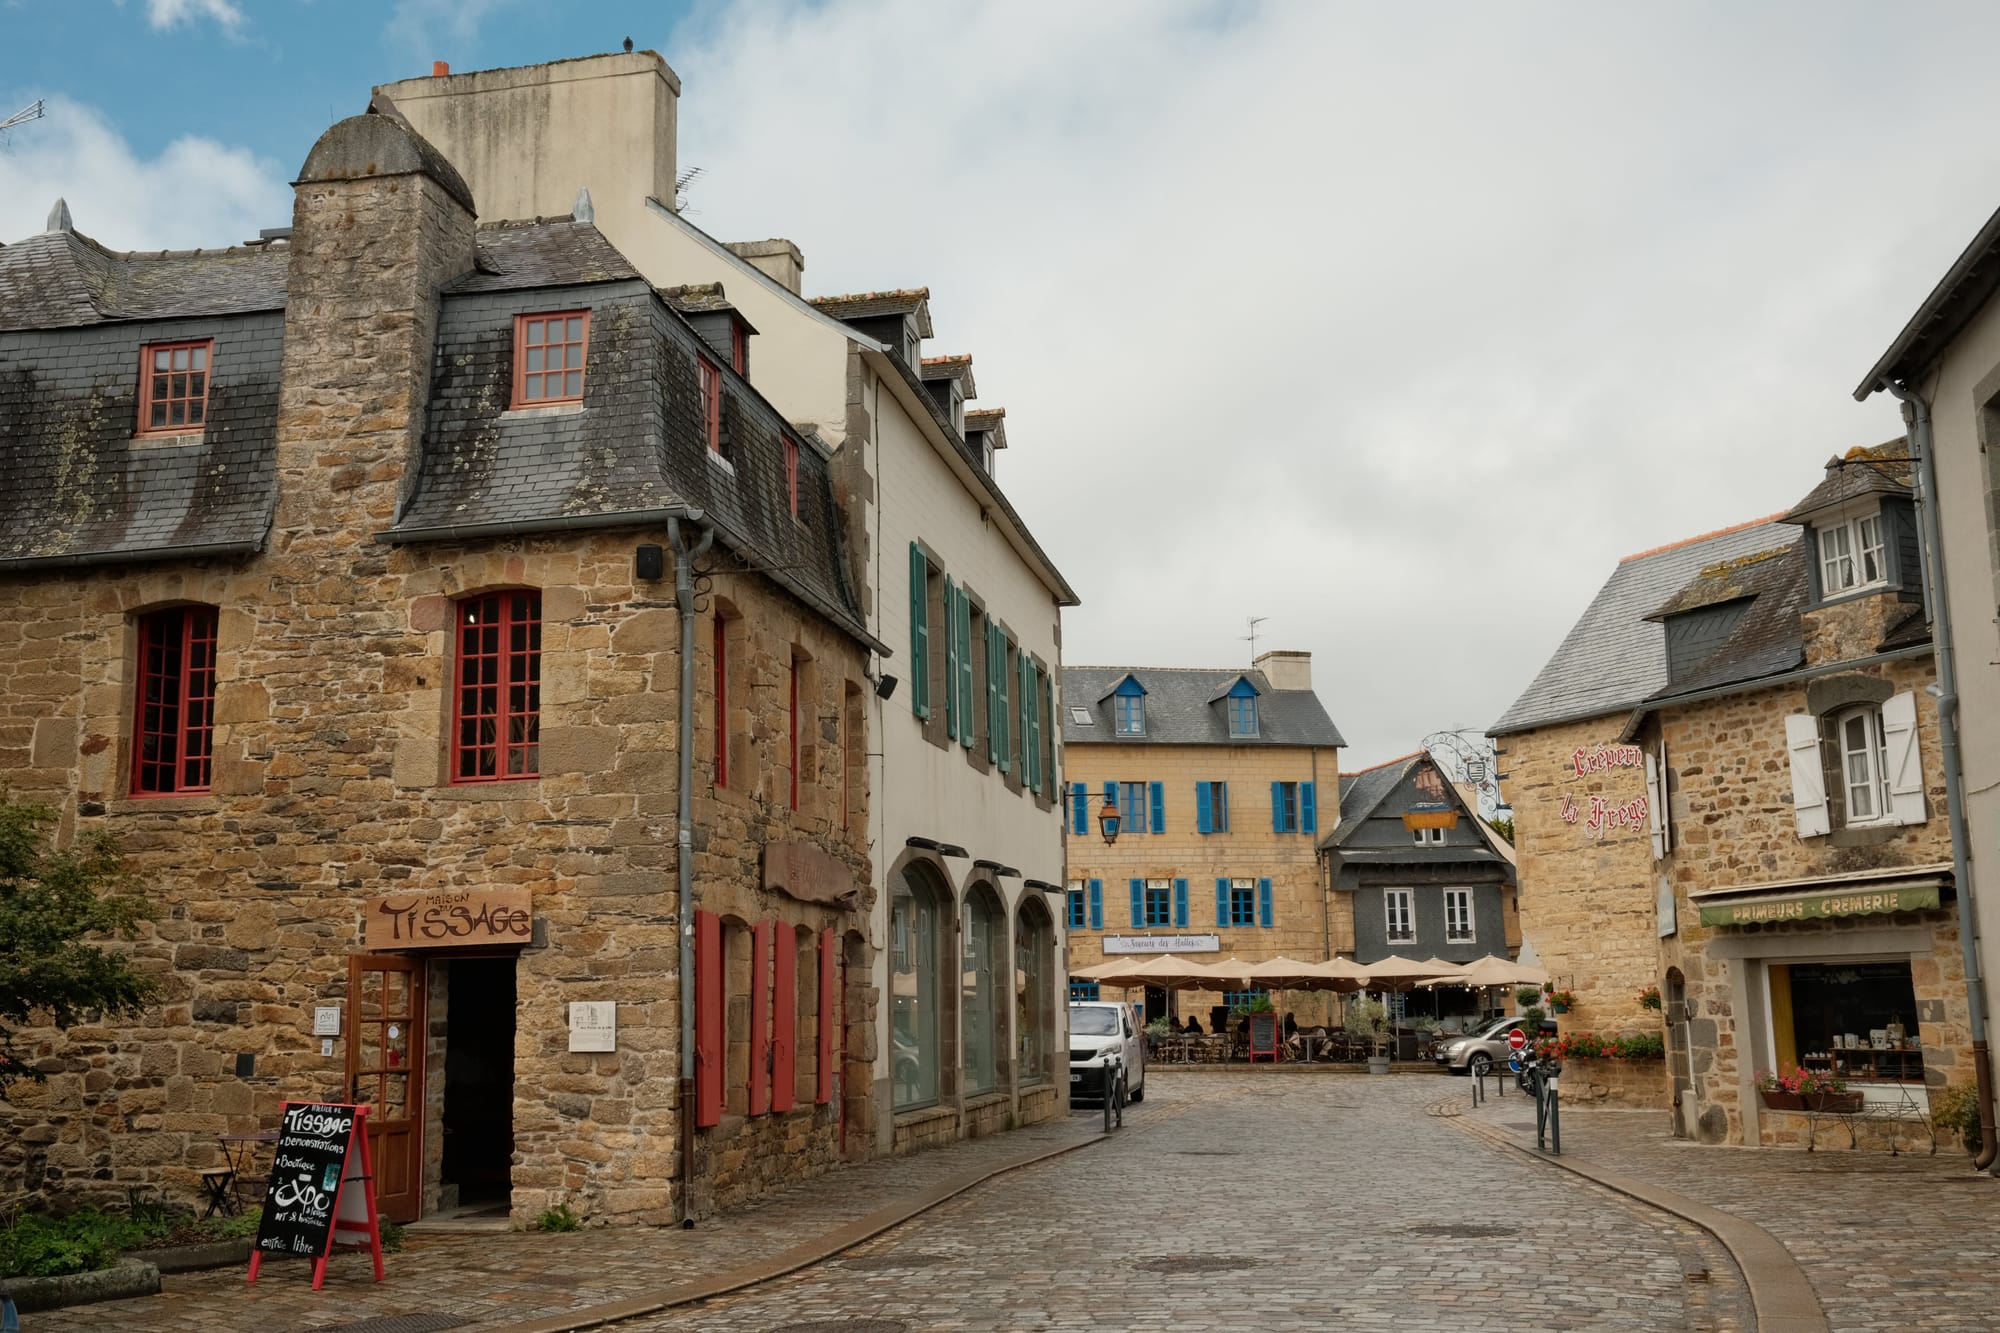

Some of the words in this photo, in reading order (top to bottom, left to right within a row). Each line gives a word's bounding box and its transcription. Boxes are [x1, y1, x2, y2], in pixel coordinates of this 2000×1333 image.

[1571, 743, 1644, 778] Crêperi
[1560, 793, 1579, 824] la
[426, 893, 470, 905] MAISON
[1733, 902, 1803, 921] PRIMEURS
[1821, 893, 1899, 914] CREMERIE
[1158, 938, 1168, 948] des
[288, 1105, 352, 1138] Tissage
[280, 1154, 316, 1171] Boutique
[292, 1234, 314, 1254] libre
